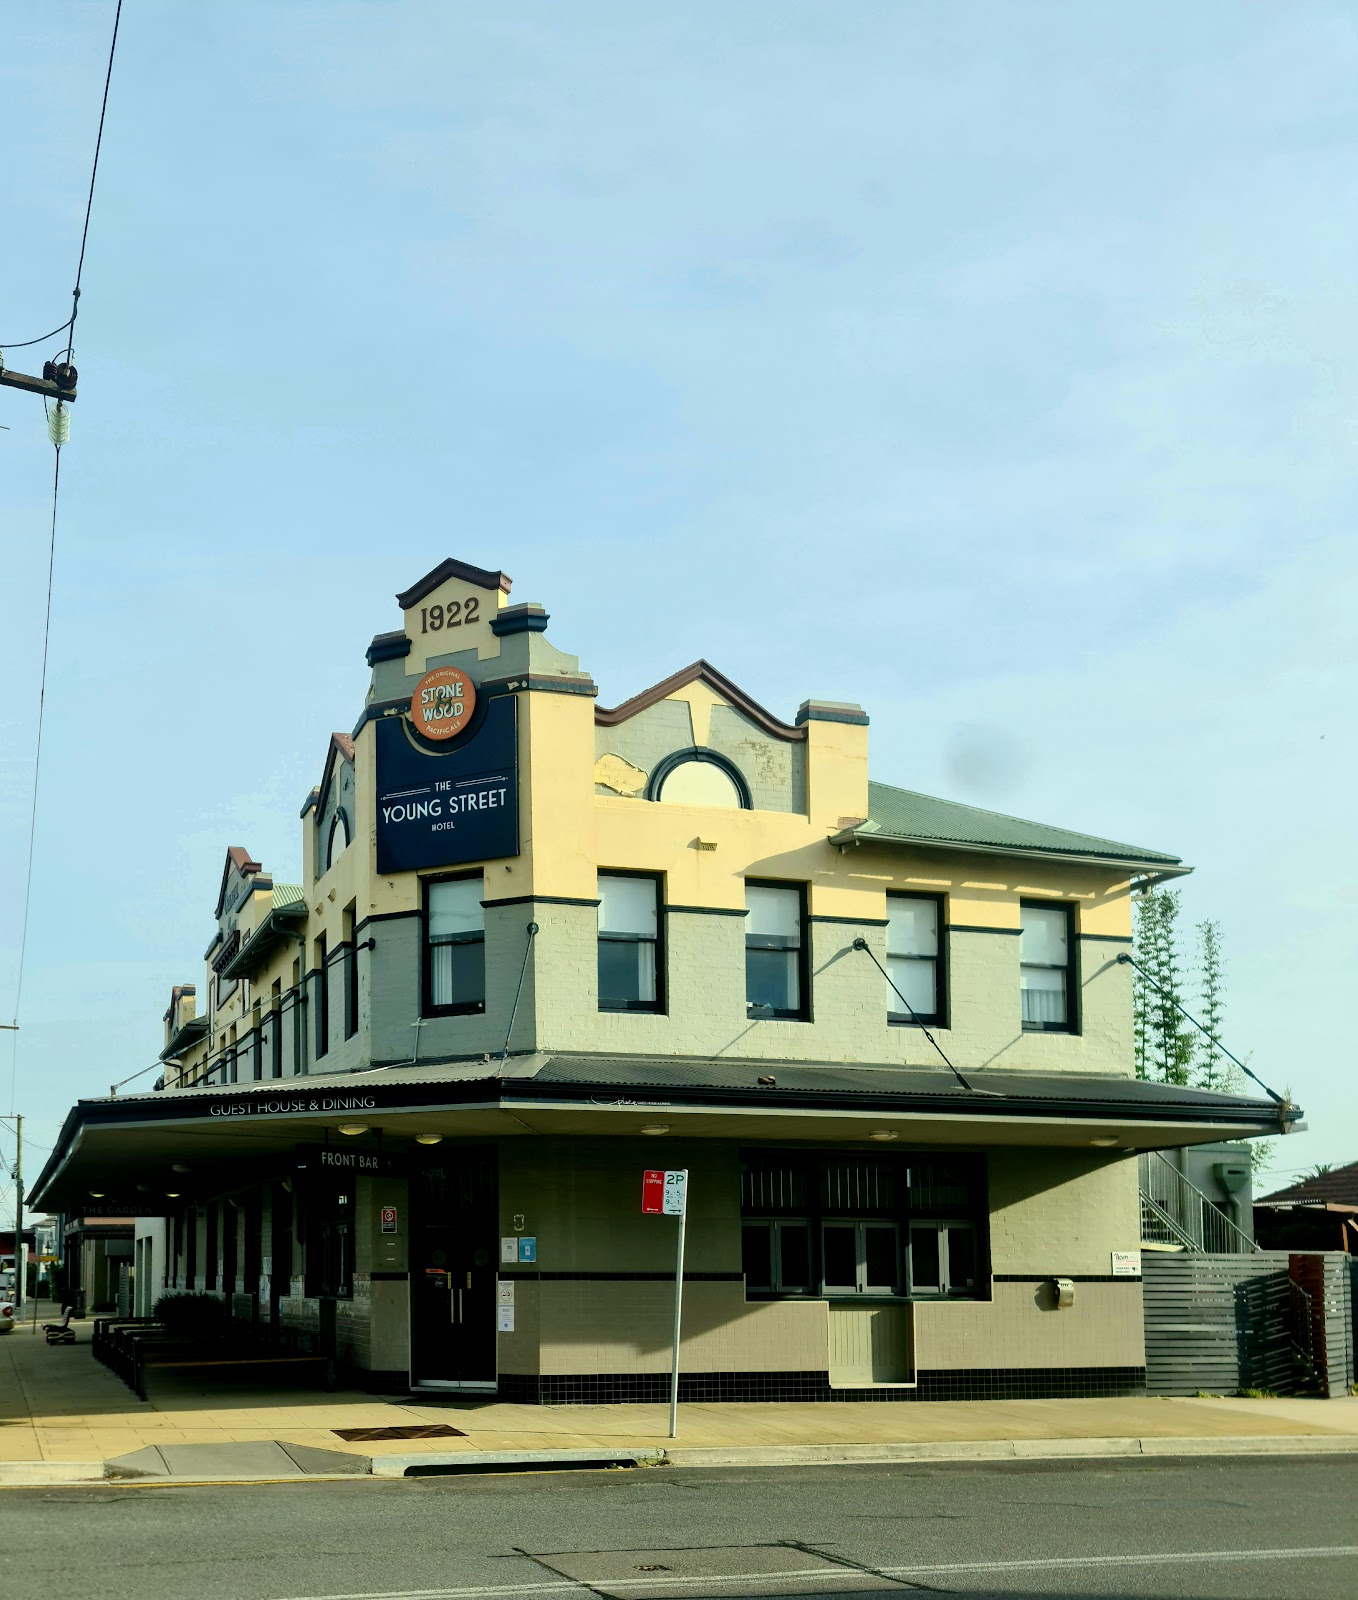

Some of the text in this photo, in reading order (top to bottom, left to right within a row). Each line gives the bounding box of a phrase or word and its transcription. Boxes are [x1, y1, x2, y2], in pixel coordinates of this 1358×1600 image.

[421, 597, 480, 634] 1922
[425, 670, 461, 685] THE ORIGINAL
[421, 682, 464, 704] STONE
[422, 702, 464, 722] WOOD
[426, 720, 462, 735] PACIFIC ALE
[435, 780, 451, 792] THE
[382, 788, 507, 824] YOUNG STREET
[431, 821, 455, 832] HOTEL
[210, 1096, 375, 1116] GUEST HOUSE & DINING
[321, 1152, 356, 1167] FRONT
[359, 1155, 379, 1169] BAR
[666, 1174, 685, 1185] 2P
[81, 1206, 153, 1214] THE GARDEN
